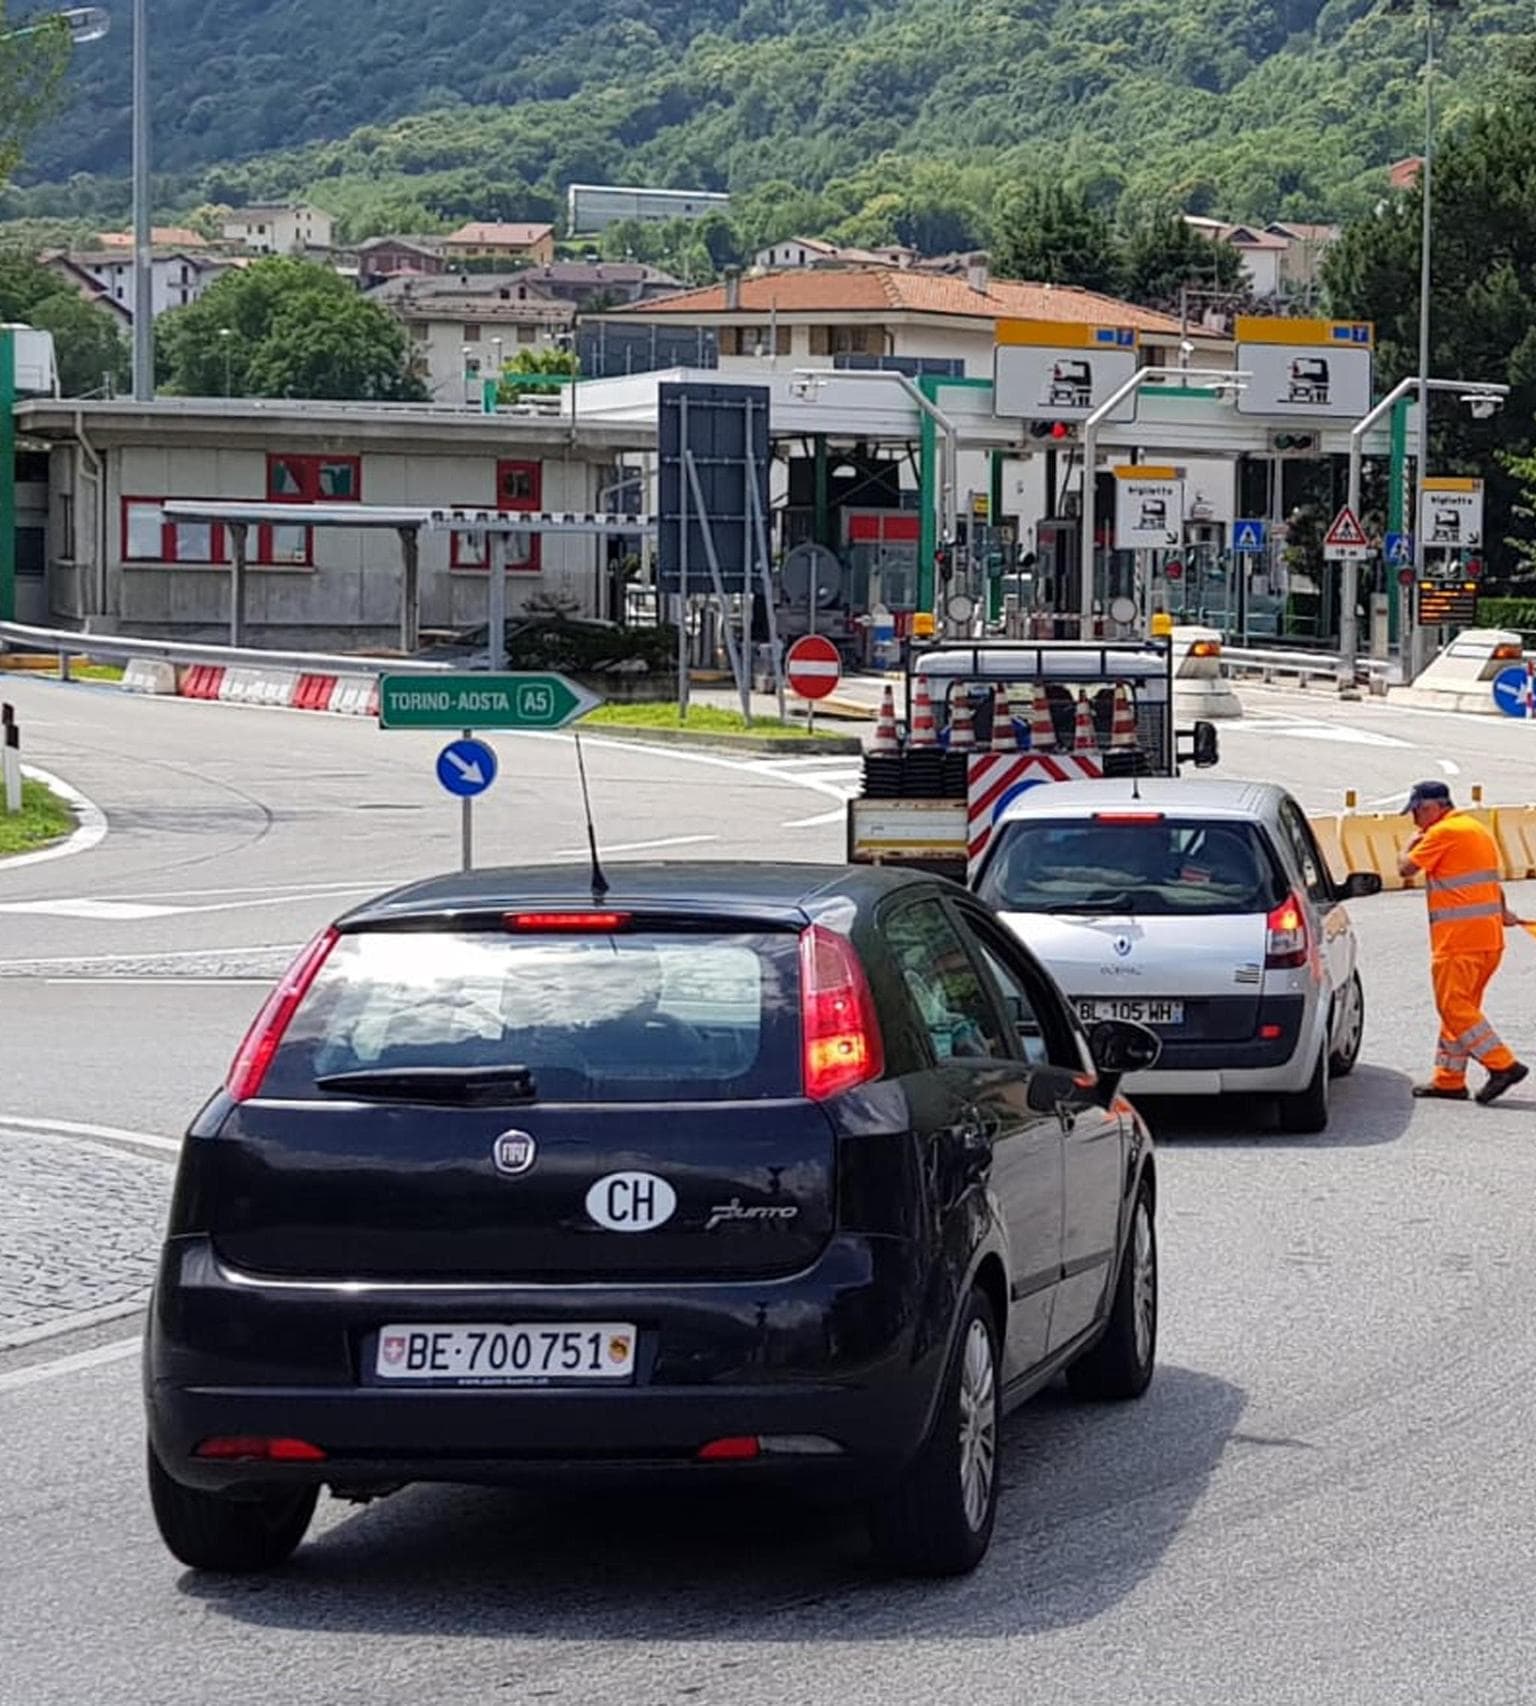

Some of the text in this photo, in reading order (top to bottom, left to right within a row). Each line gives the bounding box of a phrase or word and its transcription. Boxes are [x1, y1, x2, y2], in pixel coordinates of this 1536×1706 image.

[389, 691, 548, 712] TORINO-AOSTA A5
[608, 1180, 654, 1221] CH
